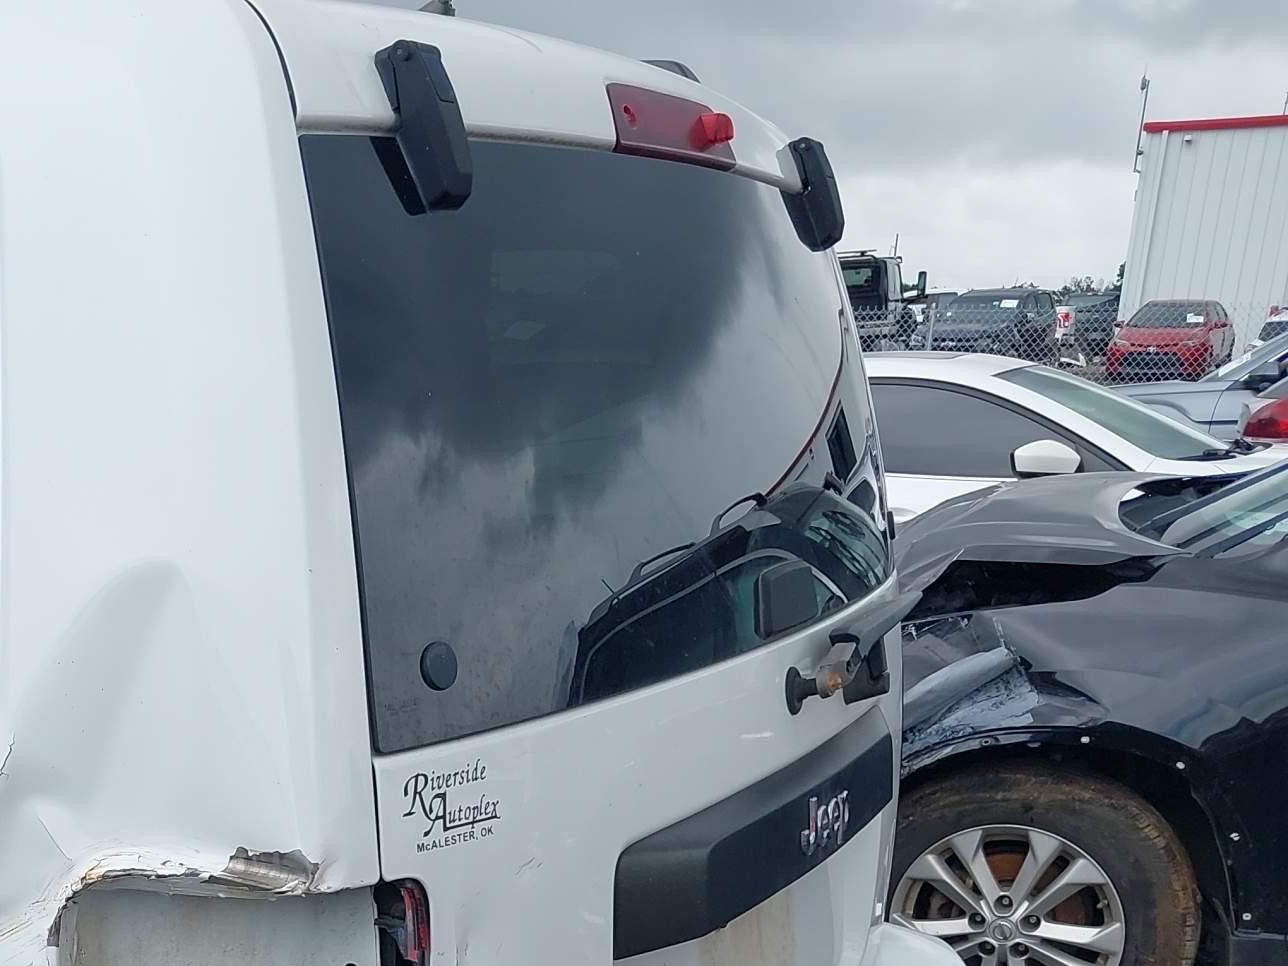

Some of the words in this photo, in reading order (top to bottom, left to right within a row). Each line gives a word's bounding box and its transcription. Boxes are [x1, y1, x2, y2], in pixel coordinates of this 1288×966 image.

[402, 758, 487, 821] Riverside
[423, 790, 501, 838] Autoplex
[416, 830, 479, 853] McALESTER,
[480, 826, 494, 838] OK
[800, 789, 849, 856] Jeep
